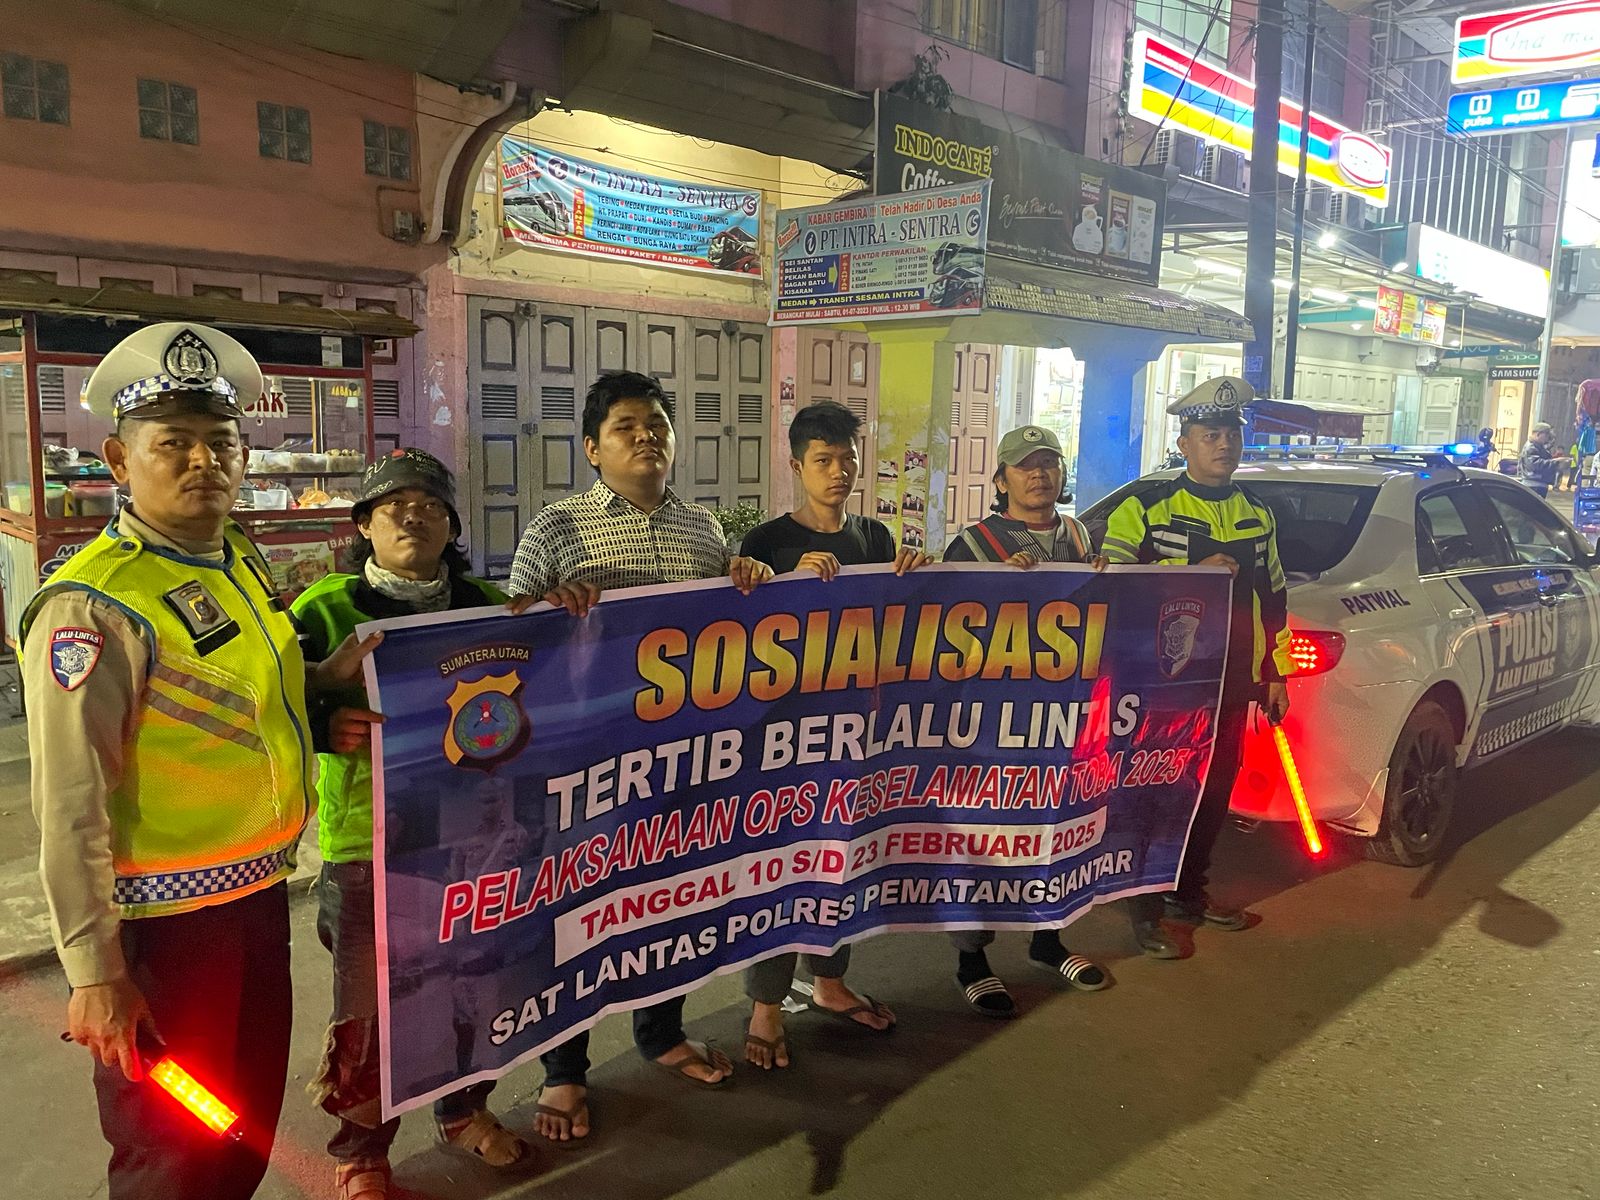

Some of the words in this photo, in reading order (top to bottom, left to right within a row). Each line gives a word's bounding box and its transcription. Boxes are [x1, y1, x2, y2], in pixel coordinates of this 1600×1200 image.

[1463, 116, 1493, 129] pulsa
[895, 124, 992, 178] INDOCAFÉ
[606, 170, 663, 198] INTRA
[676, 186, 739, 211] SENTRA
[901, 163, 955, 192] Coff
[597, 196, 620, 207] TEBING
[624, 200, 646, 211] MEDAN
[646, 204, 668, 216] AMPLAS
[673, 209, 689, 219] SETIA
[690, 211, 703, 221] BUDI
[707, 213, 729, 225] PANCING
[608, 208, 628, 220] PRAPAT
[633, 213, 647, 222] DURI
[652, 215, 672, 227] KANDIS
[677, 220, 693, 231] DUMAI
[807, 212, 832, 226] KABAR
[834, 207, 868, 222] GEMBIRA
[880, 204, 901, 216] Telah
[903, 200, 924, 214] Hadir
[927, 198, 935, 210] Di
[937, 197, 958, 209] Desa
[960, 192, 982, 206] Anda
[597, 218, 615, 229] KERINCI
[820, 229, 839, 250] PT.
[843, 222, 887, 248] INTRA
[900, 212, 960, 241] SENTRA
[571, 241, 628, 256] PENGIRIMAN
[629, 250, 656, 260] PAKET
[597, 231, 626, 243] RENGAT
[633, 235, 658, 248] BUNGA
[659, 240, 677, 250] RAYA
[684, 244, 698, 252] SIAK
[852, 252, 880, 260] KANTOR
[881, 247, 927, 258] PERWAKILAN
[785, 266, 812, 274] BELILAS
[784, 280, 807, 288] BAGAN
[784, 288, 813, 296] KISARAN
[776, 311, 804, 320] BERANGKAT
[805, 310, 821, 318] MULAI
[894, 304, 908, 312] 12.30
[781, 299, 808, 307] MEDAN
[818, 296, 854, 304] TRANSIT
[855, 292, 890, 302] SESAMA
[892, 290, 920, 299] INTRA
[1492, 369, 1540, 378] SAMSUNG
[1164, 604, 1180, 614] LALU
[1181, 602, 1200, 614] LINTAS
[1340, 589, 1412, 616] PATWAL
[56, 632, 74, 640] LALU
[1498, 606, 1558, 668] POLISI
[440, 648, 497, 676] SUMATERA
[498, 646, 530, 661] UTARA
[635, 601, 1109, 721] SOSIALISASI
[1496, 666, 1522, 693] LALU
[1522, 656, 1556, 685] LINTAS
[547, 728, 743, 832] TERTIB
[760, 702, 983, 772] BERLALU
[998, 694, 1140, 748] LINTAS
[438, 795, 738, 943] PELAKSANAAN
[744, 780, 818, 838] OPS
[822, 764, 1068, 826] KESELAMATAN
[1069, 750, 1120, 804] TOBA
[1124, 747, 1188, 788] 2025
[580, 873, 736, 940] TANGGAL
[746, 856, 784, 886] 10
[792, 848, 845, 875] S/D
[850, 836, 878, 872] 23
[884, 832, 1041, 858] FEBRUARI
[1051, 821, 1096, 856] 2025
[490, 980, 569, 1048] SAT
[575, 926, 718, 1001] LANTAS
[726, 894, 856, 945] POLRES
[862, 849, 1135, 913] PEMATANGSIANTAR
